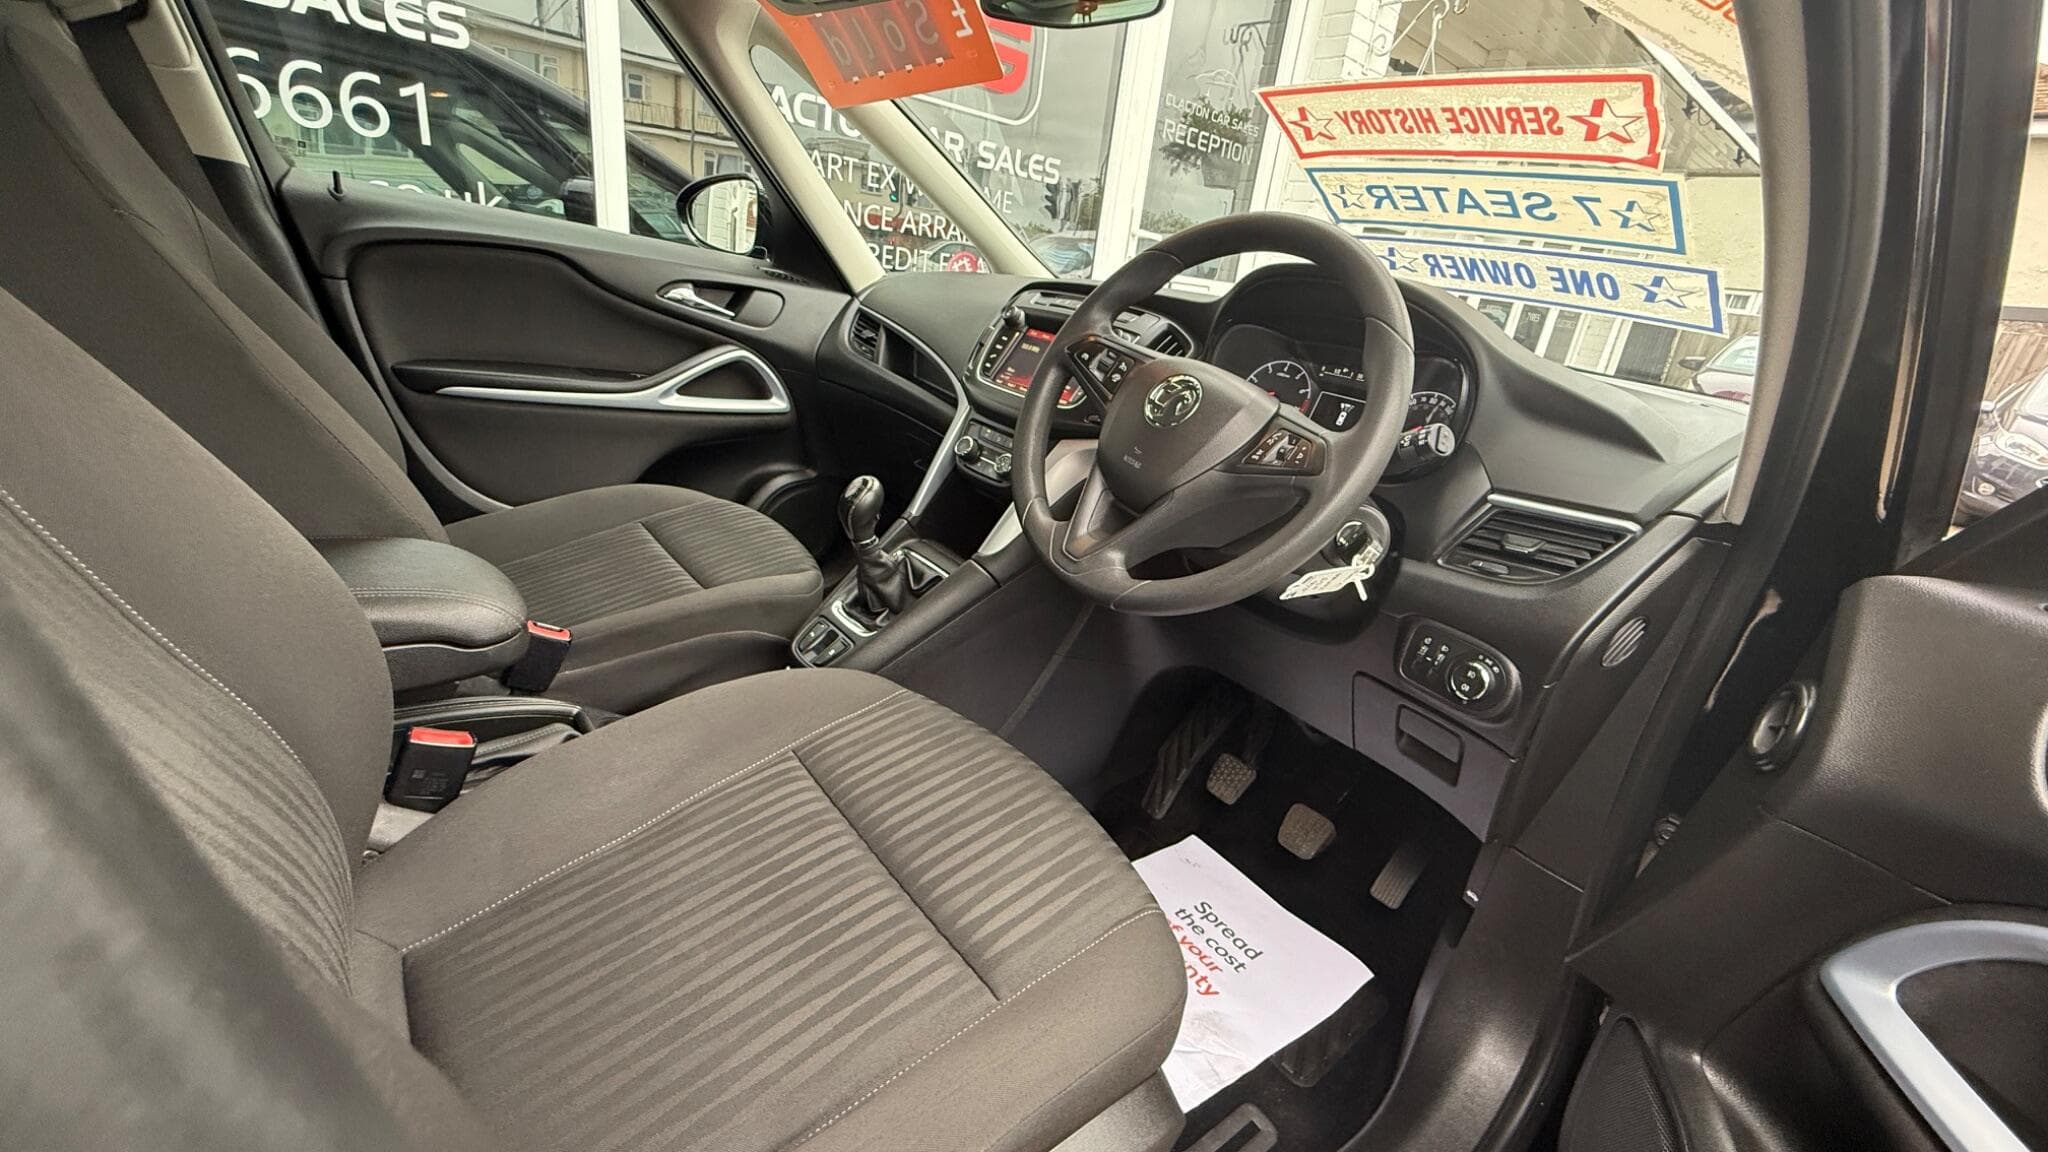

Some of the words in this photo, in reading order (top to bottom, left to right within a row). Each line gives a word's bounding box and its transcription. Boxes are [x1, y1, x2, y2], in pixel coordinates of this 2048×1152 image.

[1165, 93, 1210, 120] CLACTON
[1211, 110, 1231, 129] CAR
[1231, 118, 1260, 137] SALES
[976, 140, 1062, 185] SALES
[1162, 119, 1254, 166] RECEPTION
[866, 162, 898, 192] EX
[1175, 907, 1206, 936] the
[1205, 936, 1248, 974] cost
[1194, 900, 1264, 961] Spread
[1180, 934, 1224, 974] your
